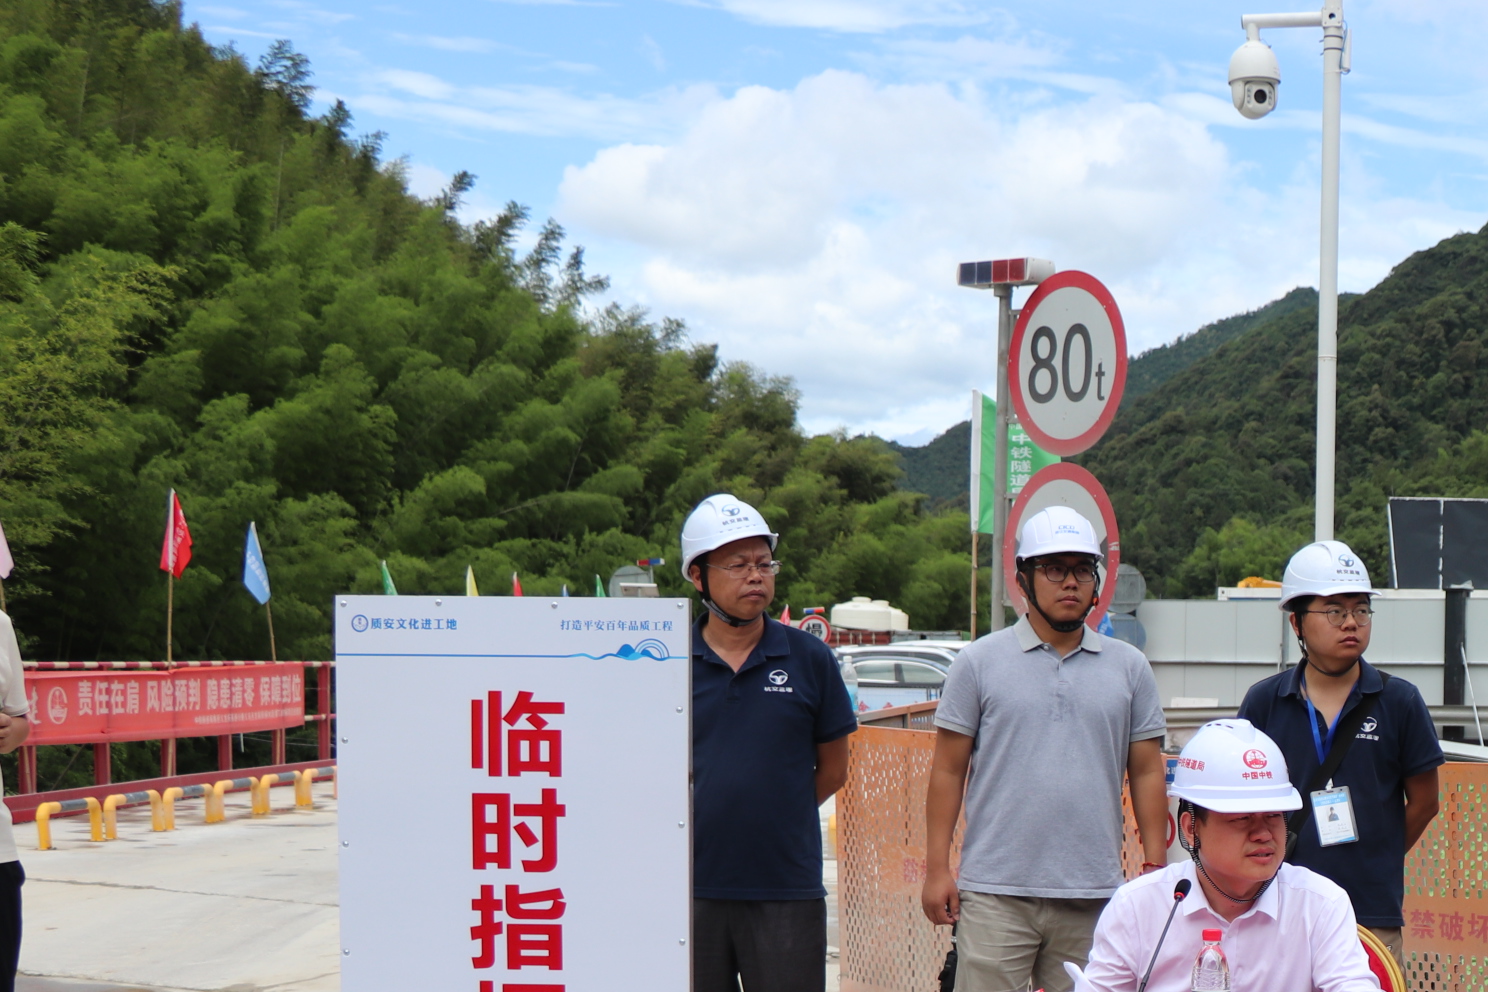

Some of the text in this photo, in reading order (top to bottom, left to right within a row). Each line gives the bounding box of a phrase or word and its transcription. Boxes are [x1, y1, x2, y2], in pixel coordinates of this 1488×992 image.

[1028, 323, 1106, 404] 80t
[370, 617, 458, 630] 质安文化进工地
[560, 619, 673, 631] 打造平安百年品质工程
[77, 679, 140, 717] 责任在肩
[146, 678, 201, 714] 风险预判
[206, 676, 255, 710] 隐患清零
[259, 674, 301, 707] 保障到位
[1241, 771, 1273, 780] 中国中铁
